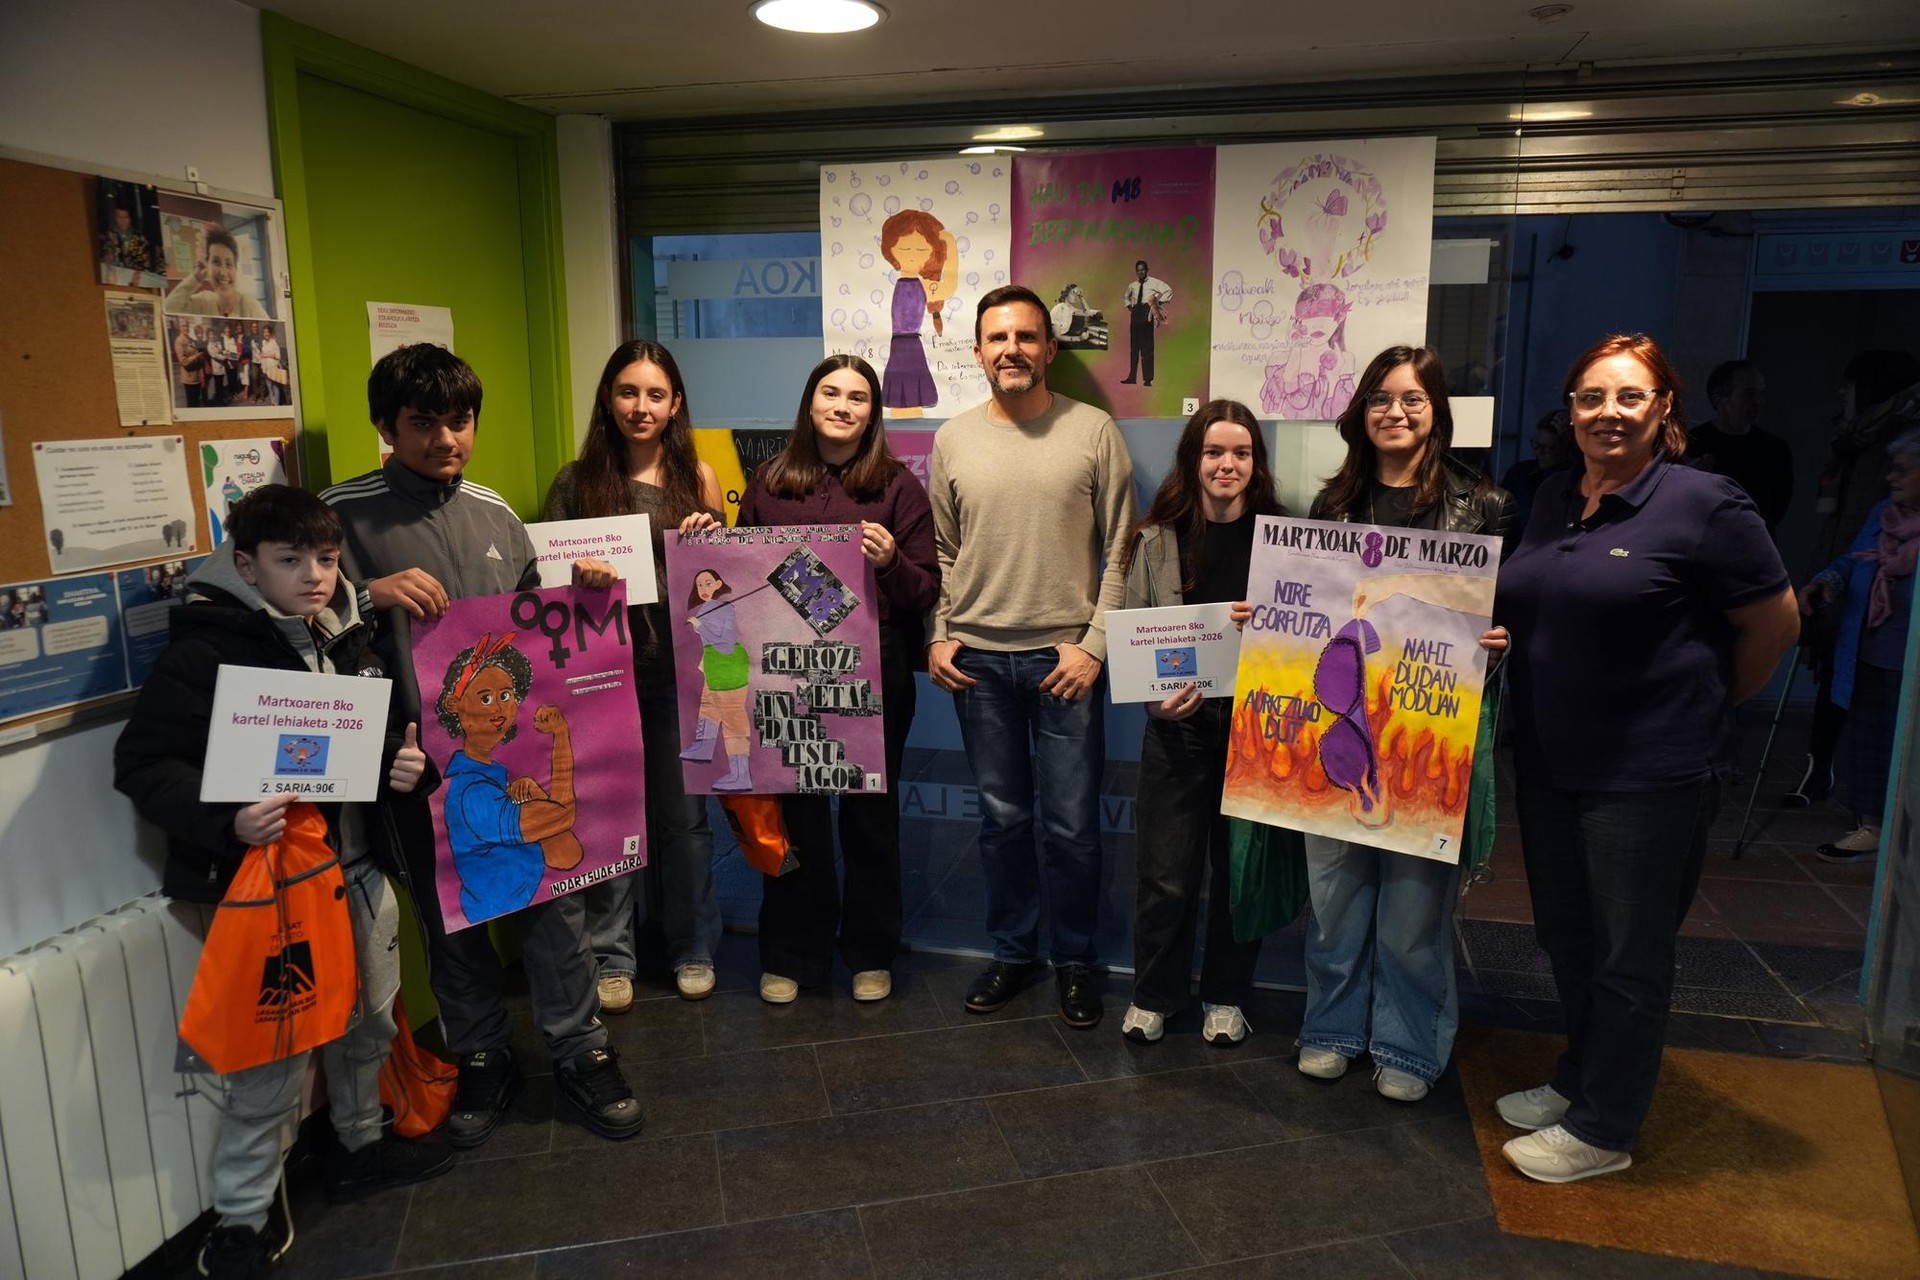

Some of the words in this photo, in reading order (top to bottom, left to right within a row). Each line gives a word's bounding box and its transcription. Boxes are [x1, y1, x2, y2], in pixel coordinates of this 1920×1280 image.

[1112, 176, 1142, 204] M8
[1186, 402, 1194, 412] 3
[549, 536, 603, 548] Martxoaren
[605, 533, 622, 543] 8ko
[1263, 524, 1364, 557] MARTXOAK
[1361, 531, 1384, 568] 8
[1384, 535, 1410, 560] DE
[1419, 538, 1489, 570] MARZO
[563, 548, 606, 561] lehiaketa
[608, 545, 633, 556] -2026
[1136, 624, 1187, 634] Martxoaren
[1189, 621, 1205, 631] 8ko
[1130, 637, 1156, 647] kartel
[1157, 635, 1197, 645] lehiaketa
[1199, 632, 1223, 641] -2026
[770, 646, 854, 671] GEROZ
[1403, 638, 1454, 669] NAHI
[1394, 663, 1458, 693] DUDAN
[258, 694, 330, 711] Martxoaren
[333, 699, 354, 712] 8ko
[763, 694, 790, 719] IN
[813, 684, 862, 709] ETA
[232, 713, 270, 726] kartel
[273, 714, 328, 729] lehiaketa
[331, 718, 364, 731] -2026
[765, 719, 817, 741] DAR
[790, 742, 838, 765] TSU
[261, 783, 272, 794] 2.
[275, 782, 335, 794] SARIA:90€
[801, 767, 849, 790] AGO
[870, 778, 876, 787] 1
[630, 840, 636, 851] 8
[1440, 837, 1448, 850] 7
[550, 866, 615, 896] INDARTSUAK
[615, 856, 643, 874] GARA
